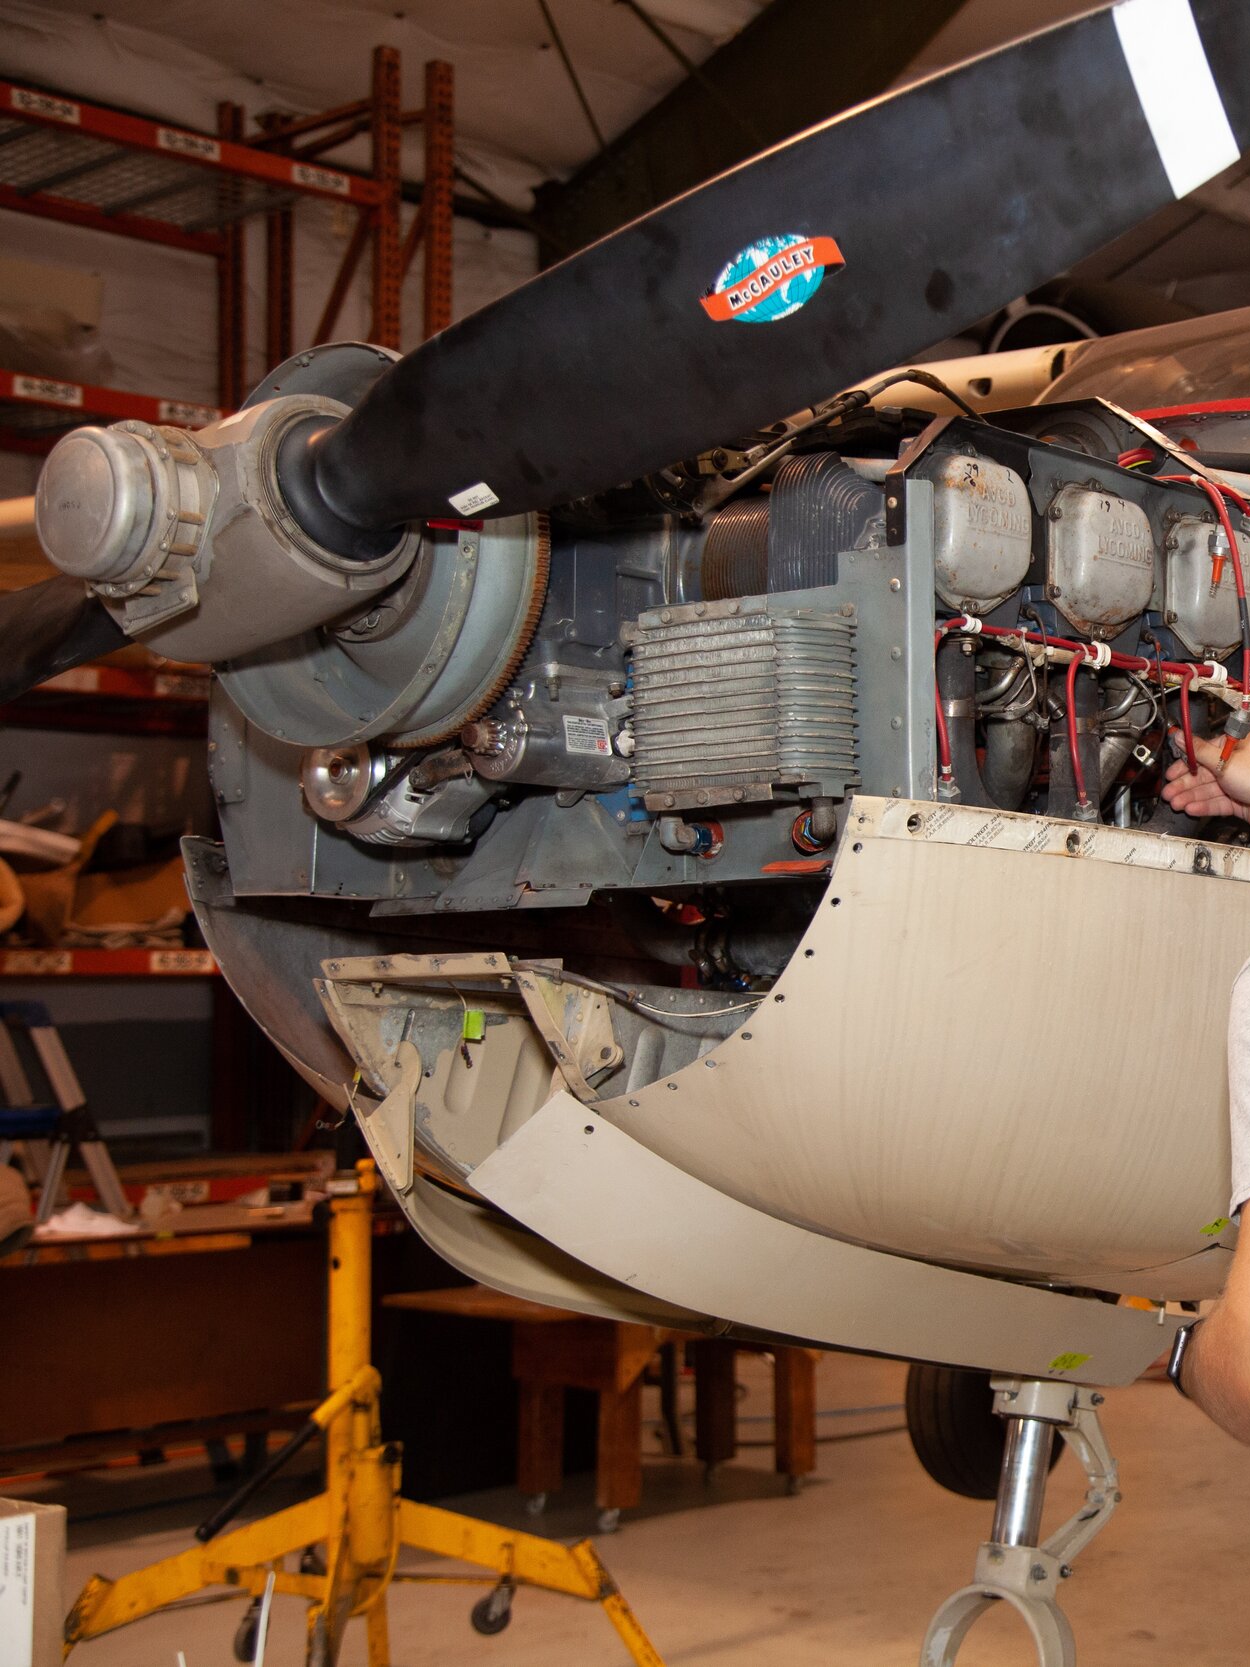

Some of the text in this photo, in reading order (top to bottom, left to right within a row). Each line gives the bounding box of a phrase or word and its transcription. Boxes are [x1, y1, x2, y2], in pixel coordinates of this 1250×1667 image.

[729, 246, 814, 310] McCAULEY
[983, 486, 1017, 508] AVCO
[968, 501, 1030, 533] LYCOMING
[1111, 519, 1140, 540] AVCO
[1098, 536, 1153, 565] LYCOMING
